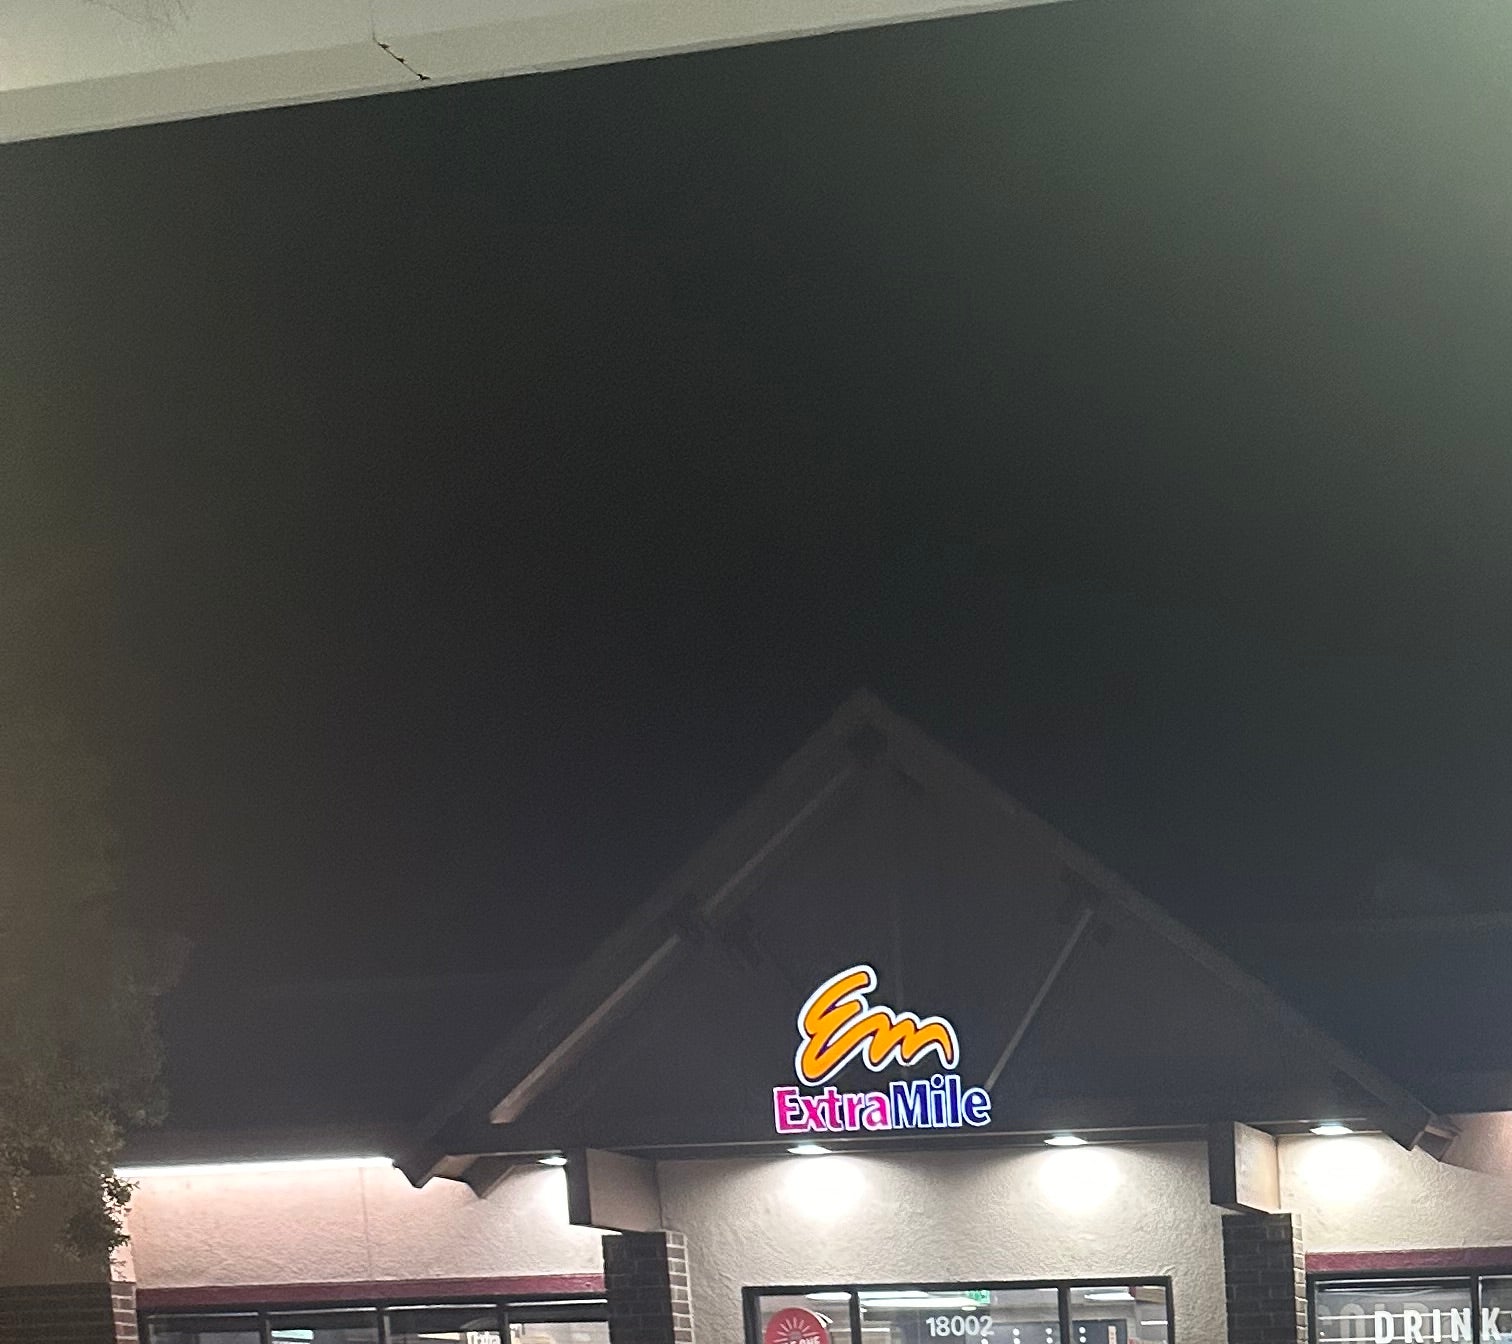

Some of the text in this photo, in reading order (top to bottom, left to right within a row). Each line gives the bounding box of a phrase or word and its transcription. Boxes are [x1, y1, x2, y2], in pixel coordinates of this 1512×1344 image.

[796, 965, 959, 1086] Em
[773, 1073, 991, 1134] ExtraMile
[925, 1315, 995, 1337] 18002
